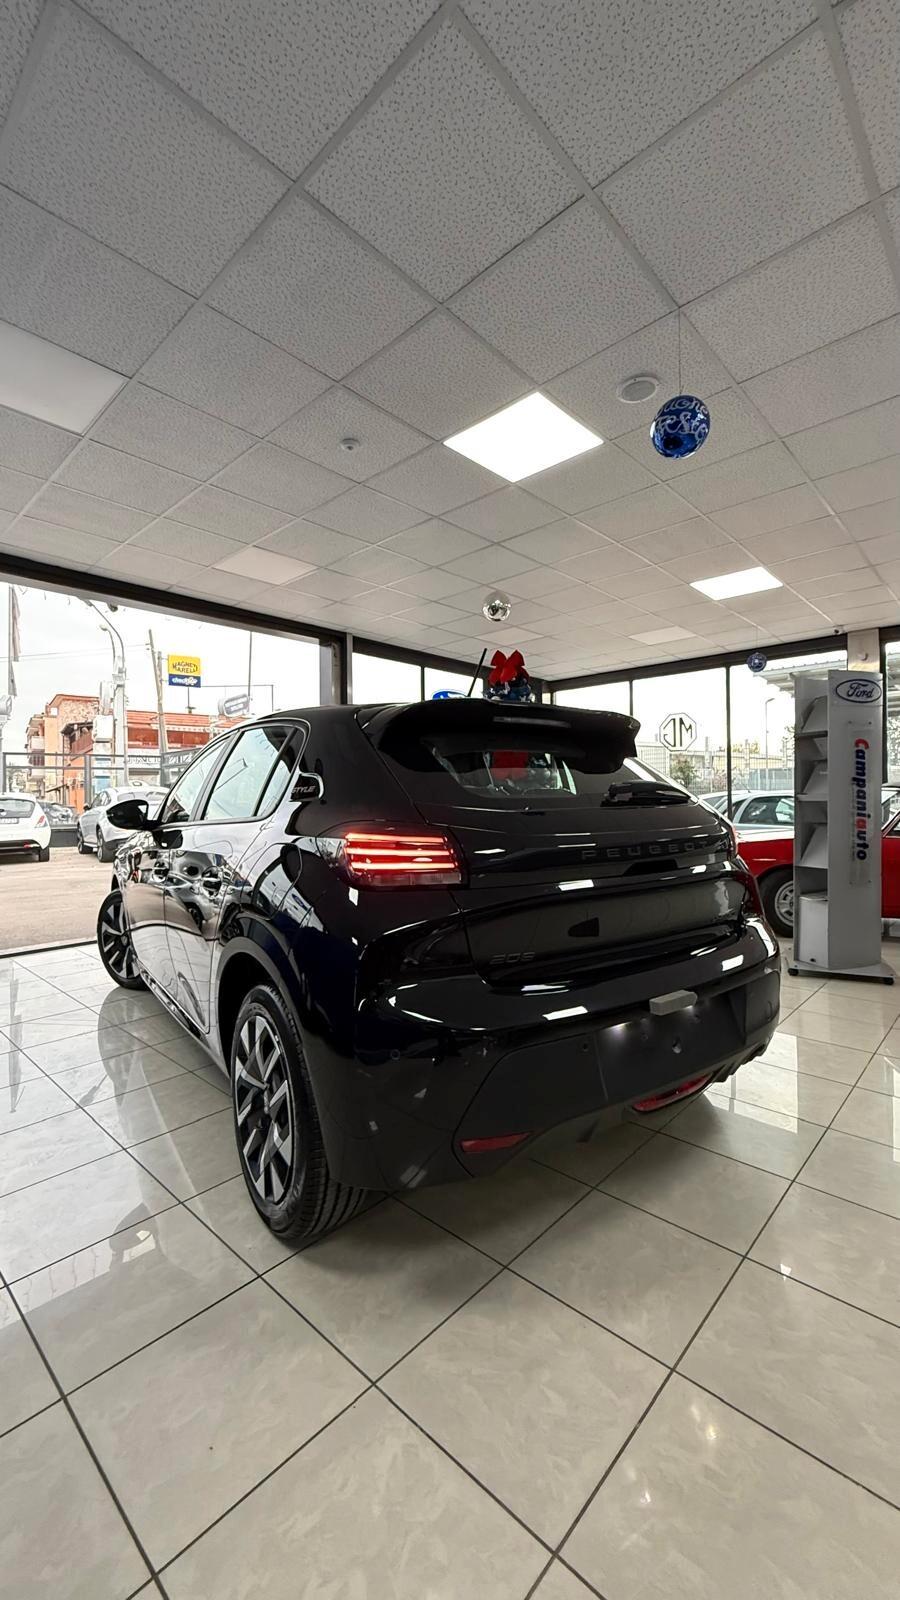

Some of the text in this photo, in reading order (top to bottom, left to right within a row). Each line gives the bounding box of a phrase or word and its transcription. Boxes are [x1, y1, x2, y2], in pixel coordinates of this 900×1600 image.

[845, 682, 875, 699] Ford
[291, 784, 316, 794] STYLE
[852, 738, 871, 860] Campaniauto
[581, 841, 708, 860] PEUGEOT
